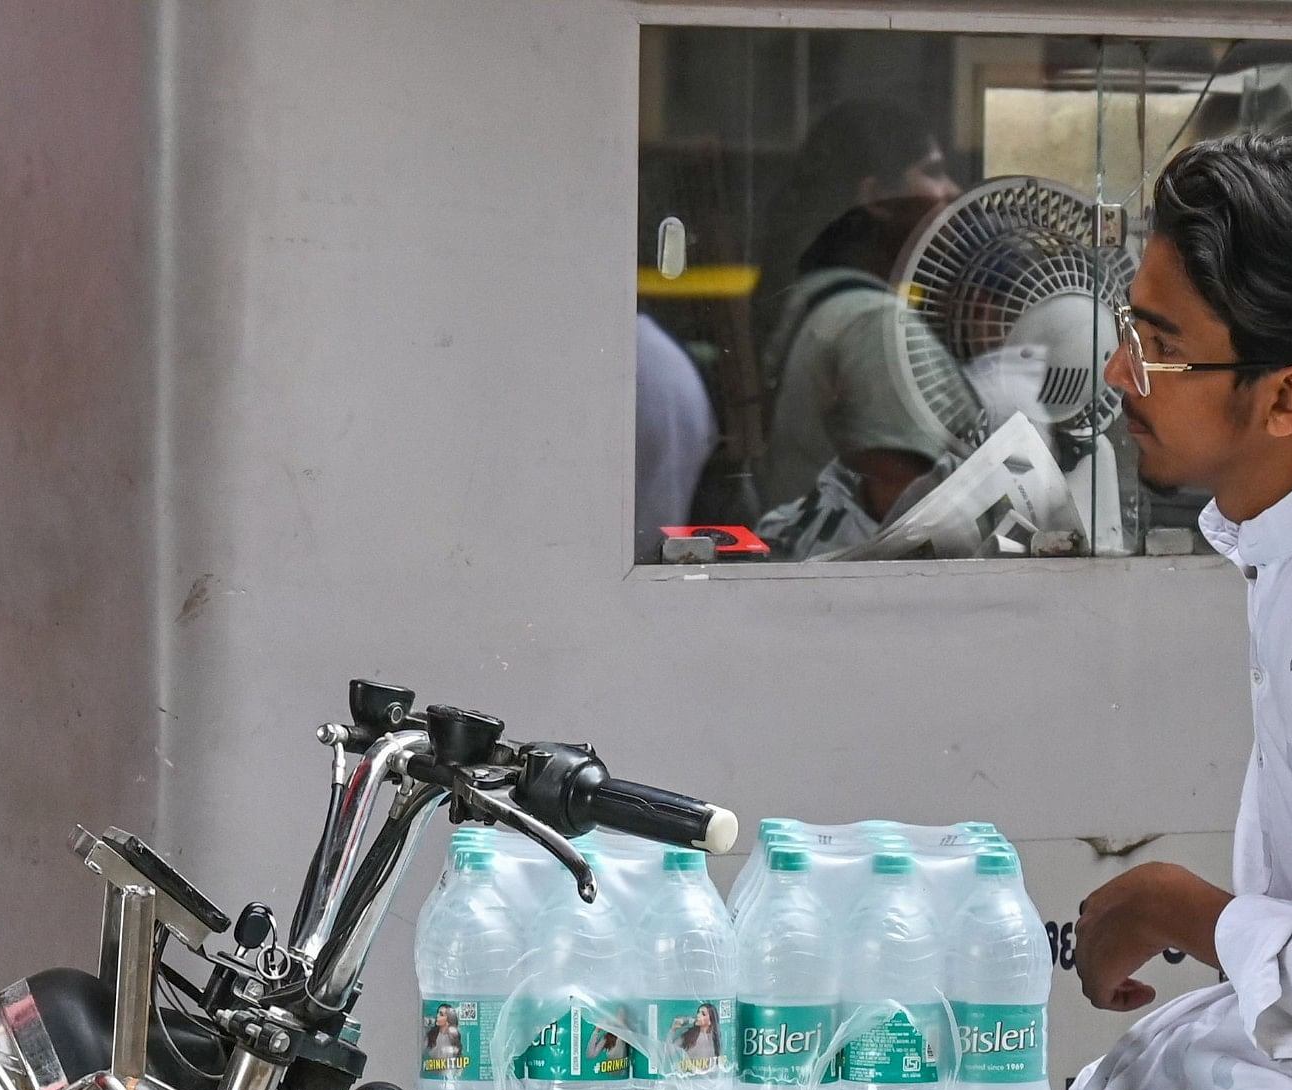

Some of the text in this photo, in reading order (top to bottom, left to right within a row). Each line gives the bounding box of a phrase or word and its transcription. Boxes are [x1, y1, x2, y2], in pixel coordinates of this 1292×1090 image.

[742, 1022, 822, 1056] Bisleri
[956, 1020, 1036, 1054] Bisleri
[1006, 1063, 1025, 1071] 1969
